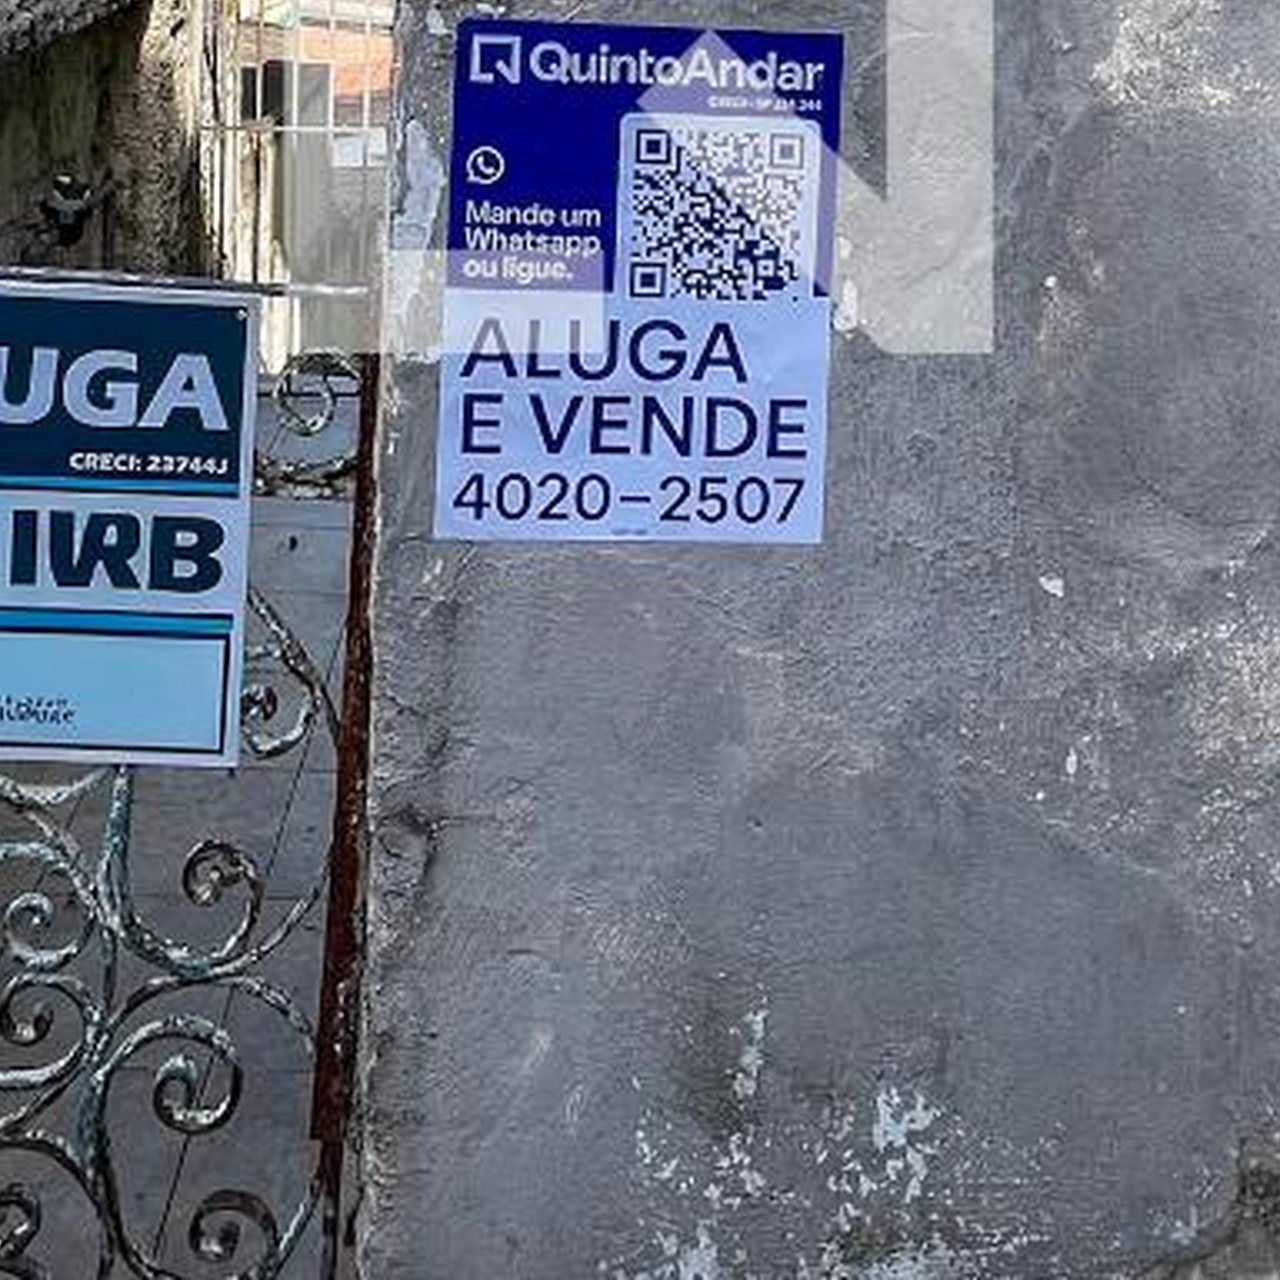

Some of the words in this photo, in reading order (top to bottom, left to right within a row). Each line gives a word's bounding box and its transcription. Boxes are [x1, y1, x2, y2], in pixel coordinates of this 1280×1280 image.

[530, 40, 825, 92] QuintoAndar
[465, 200, 557, 227] Mande
[561, 208, 602, 227] um
[464, 226, 601, 259] Whatsapp
[463, 259, 497, 279] ou
[460, 318, 749, 383] ALUGA
[461, 393, 503, 455] E
[529, 394, 808, 458] VENDE
[69, 452, 142, 472] CRECI:
